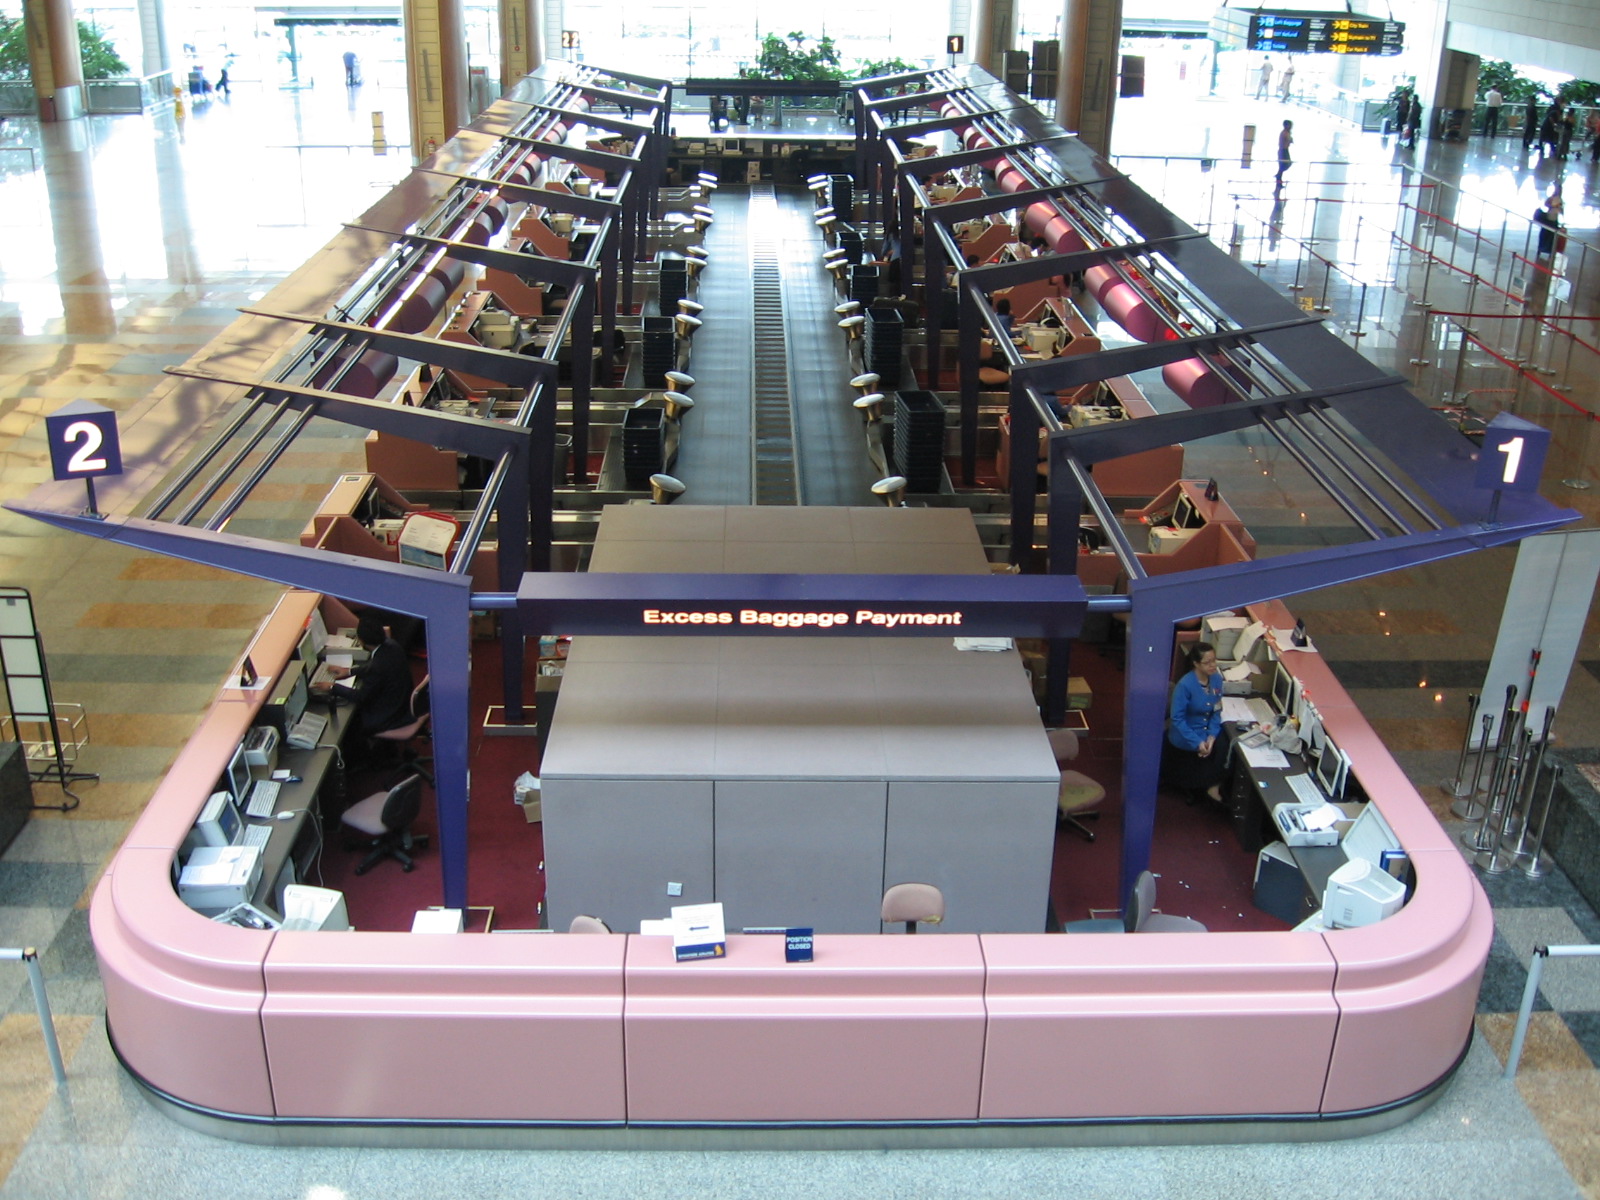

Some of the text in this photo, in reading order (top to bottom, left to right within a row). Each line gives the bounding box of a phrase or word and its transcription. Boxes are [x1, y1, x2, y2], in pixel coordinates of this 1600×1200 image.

[563, 32, 570, 47] 2
[950, 37, 959, 52] 1
[63, 420, 107, 472] 2
[1497, 436, 1524, 483] 1
[642, 609, 963, 628] Excess Baggage Payment
